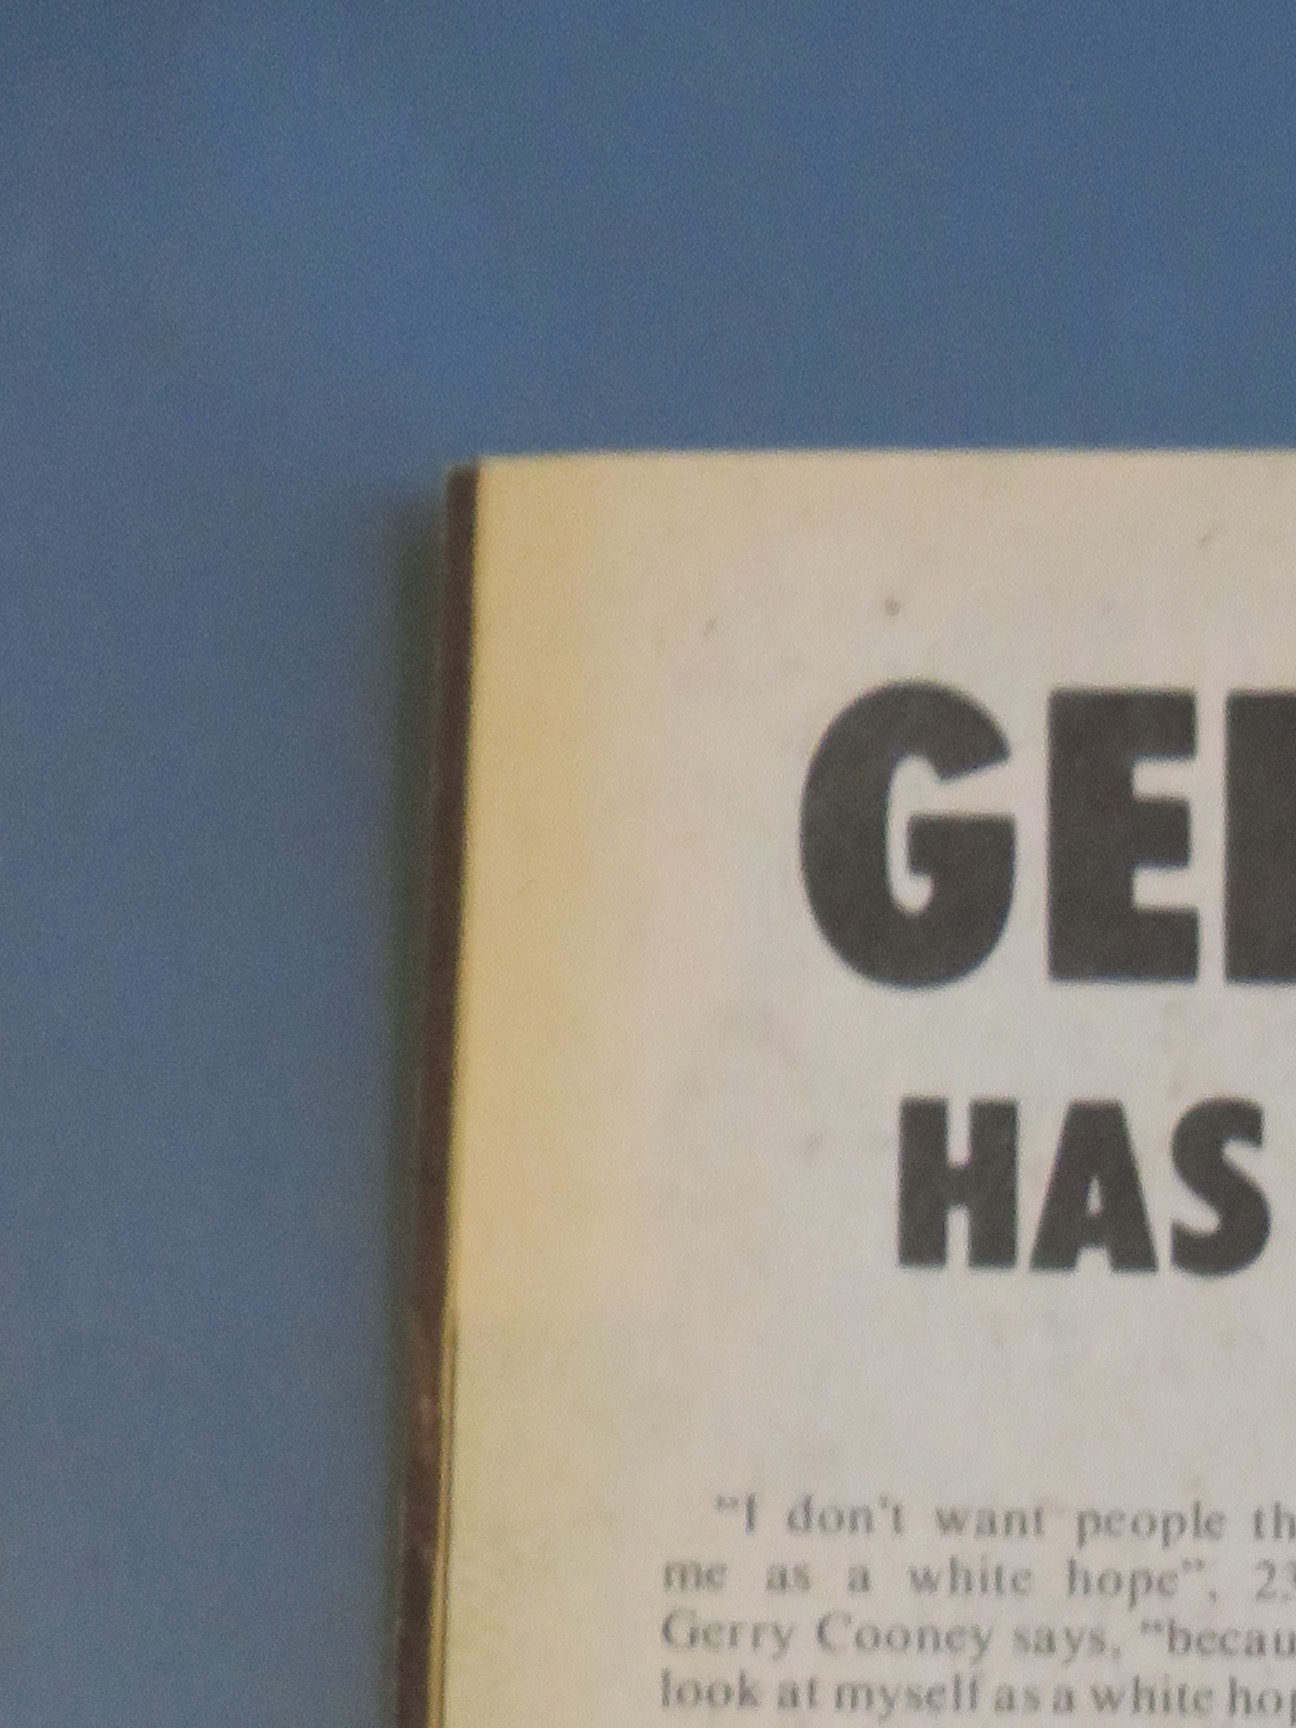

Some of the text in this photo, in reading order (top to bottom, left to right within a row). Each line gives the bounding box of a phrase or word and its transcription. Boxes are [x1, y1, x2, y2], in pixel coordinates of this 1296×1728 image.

[896, 1096, 1273, 1279] HAS
[783, 1491, 906, 1537] don't
[932, 1502, 1047, 1541] want
[1073, 1497, 1228, 1553] people
[660, 1558, 730, 1596] me
[763, 1561, 814, 1597] as
[845, 1562, 874, 1597] a
[906, 1553, 1035, 1599] white
[658, 1606, 796, 1663] Gerry
[813, 1610, 995, 1668] Cooney
[1011, 1624, 1124, 1668] says,
